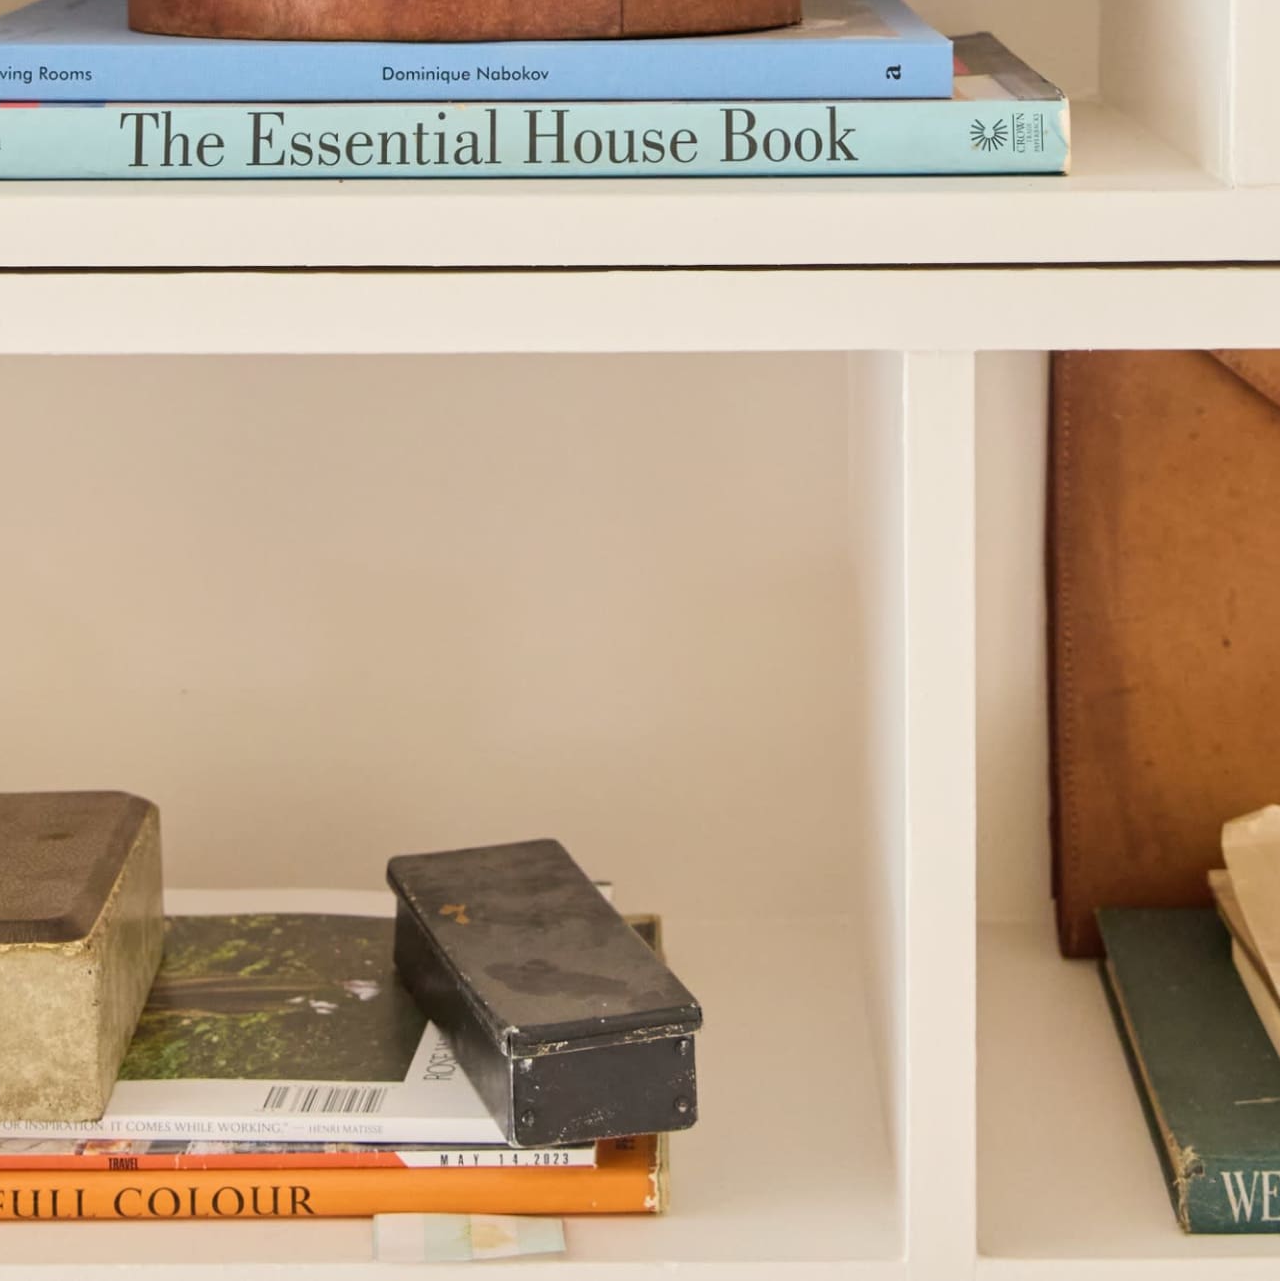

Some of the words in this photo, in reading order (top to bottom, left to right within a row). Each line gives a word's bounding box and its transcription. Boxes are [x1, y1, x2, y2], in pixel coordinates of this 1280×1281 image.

[39, 67, 93, 81] Rooms
[382, 65, 471, 85] Dominique
[477, 65, 549, 82] Nabokov
[119, 110, 225, 168] The
[245, 107, 502, 167] Essential
[522, 108, 699, 165] House
[719, 106, 859, 162] Book
[1016, 113, 1025, 153] CROWN
[110, 1120, 123, 1131] IT
[126, 1120, 171, 1132] COMES
[174, 1121, 215, 1133] WHILE
[309, 1124, 340, 1134] HENRI
[342, 1124, 384, 1135] MATISSE
[108, 1158, 139, 1171] TRAVEL
[113, 1186, 315, 1218] COLOUR
